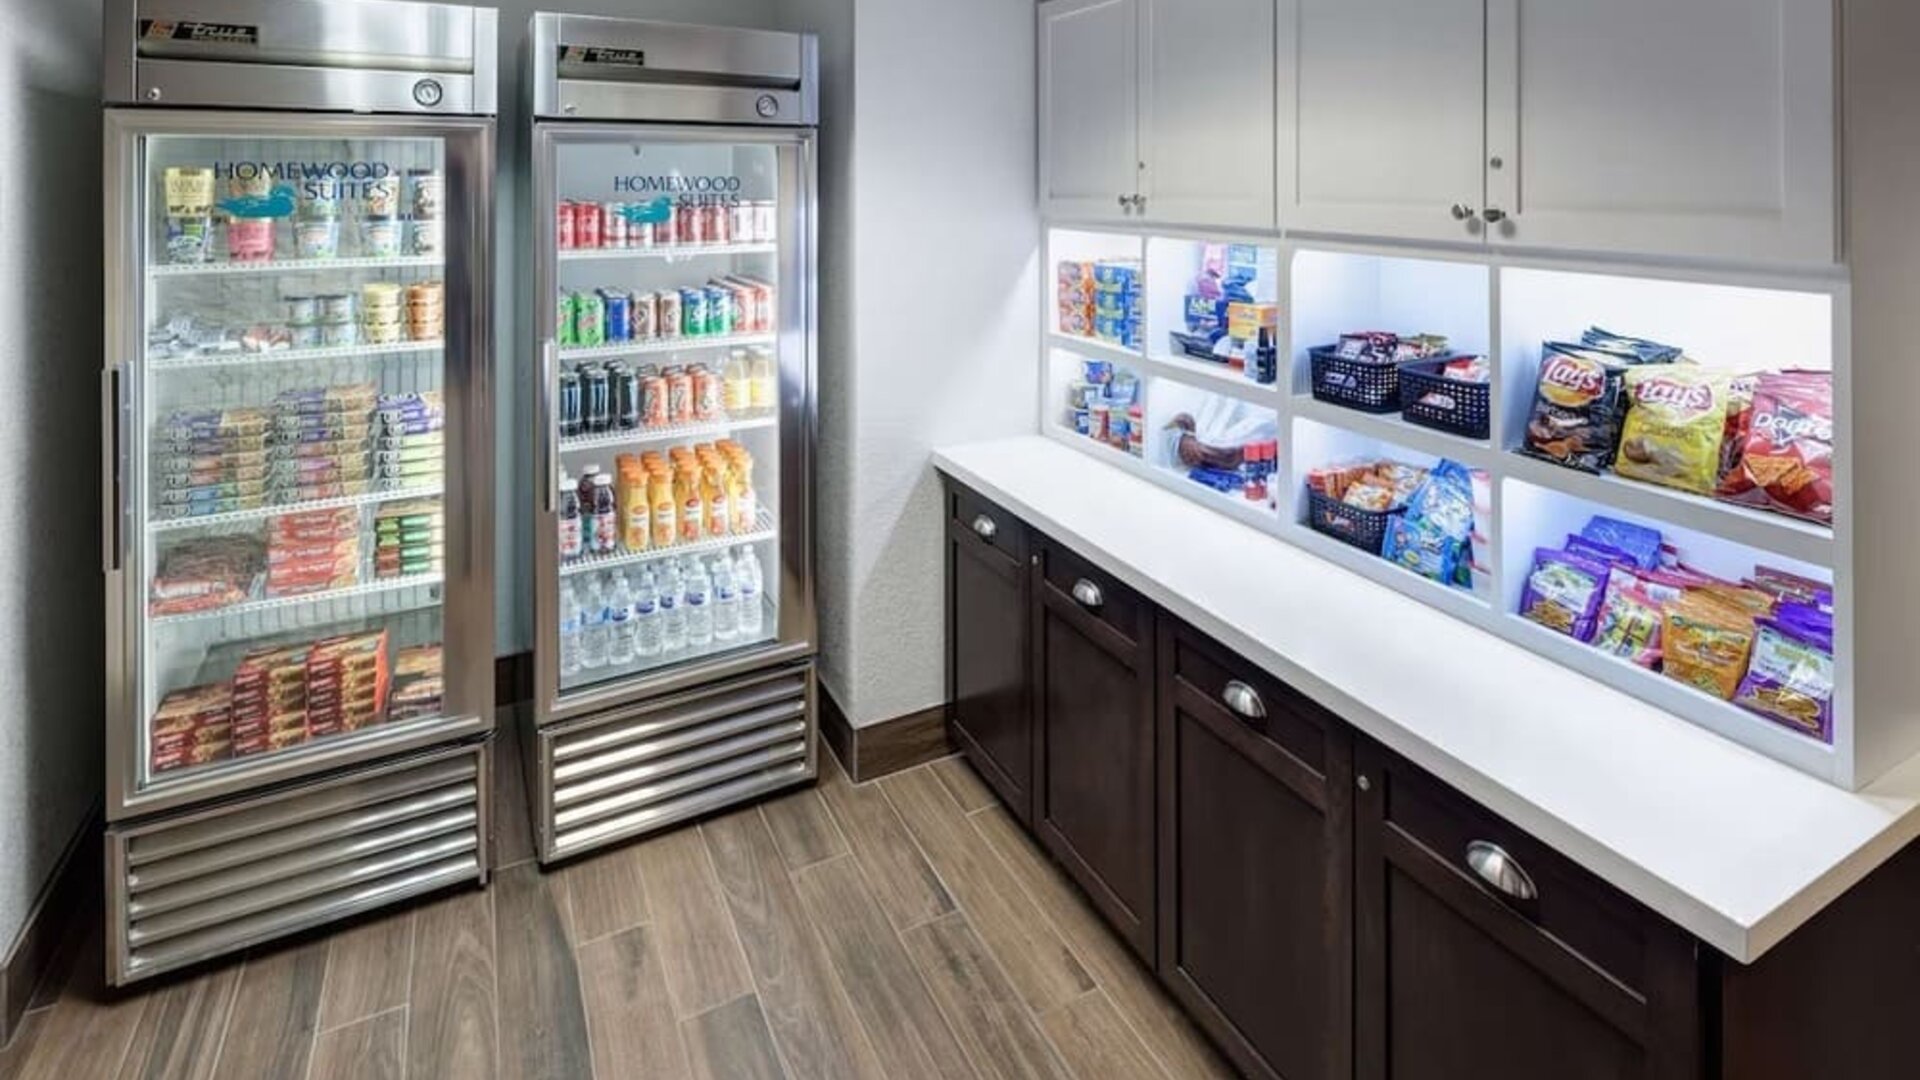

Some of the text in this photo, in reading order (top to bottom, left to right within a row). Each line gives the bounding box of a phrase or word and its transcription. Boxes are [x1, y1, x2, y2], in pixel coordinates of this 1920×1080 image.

[214, 161, 390, 180] HOMEWOOD
[304, 181, 389, 200] SUITES
[613, 175, 740, 192] HOMEWOOD
[678, 193, 740, 208] SUITES
